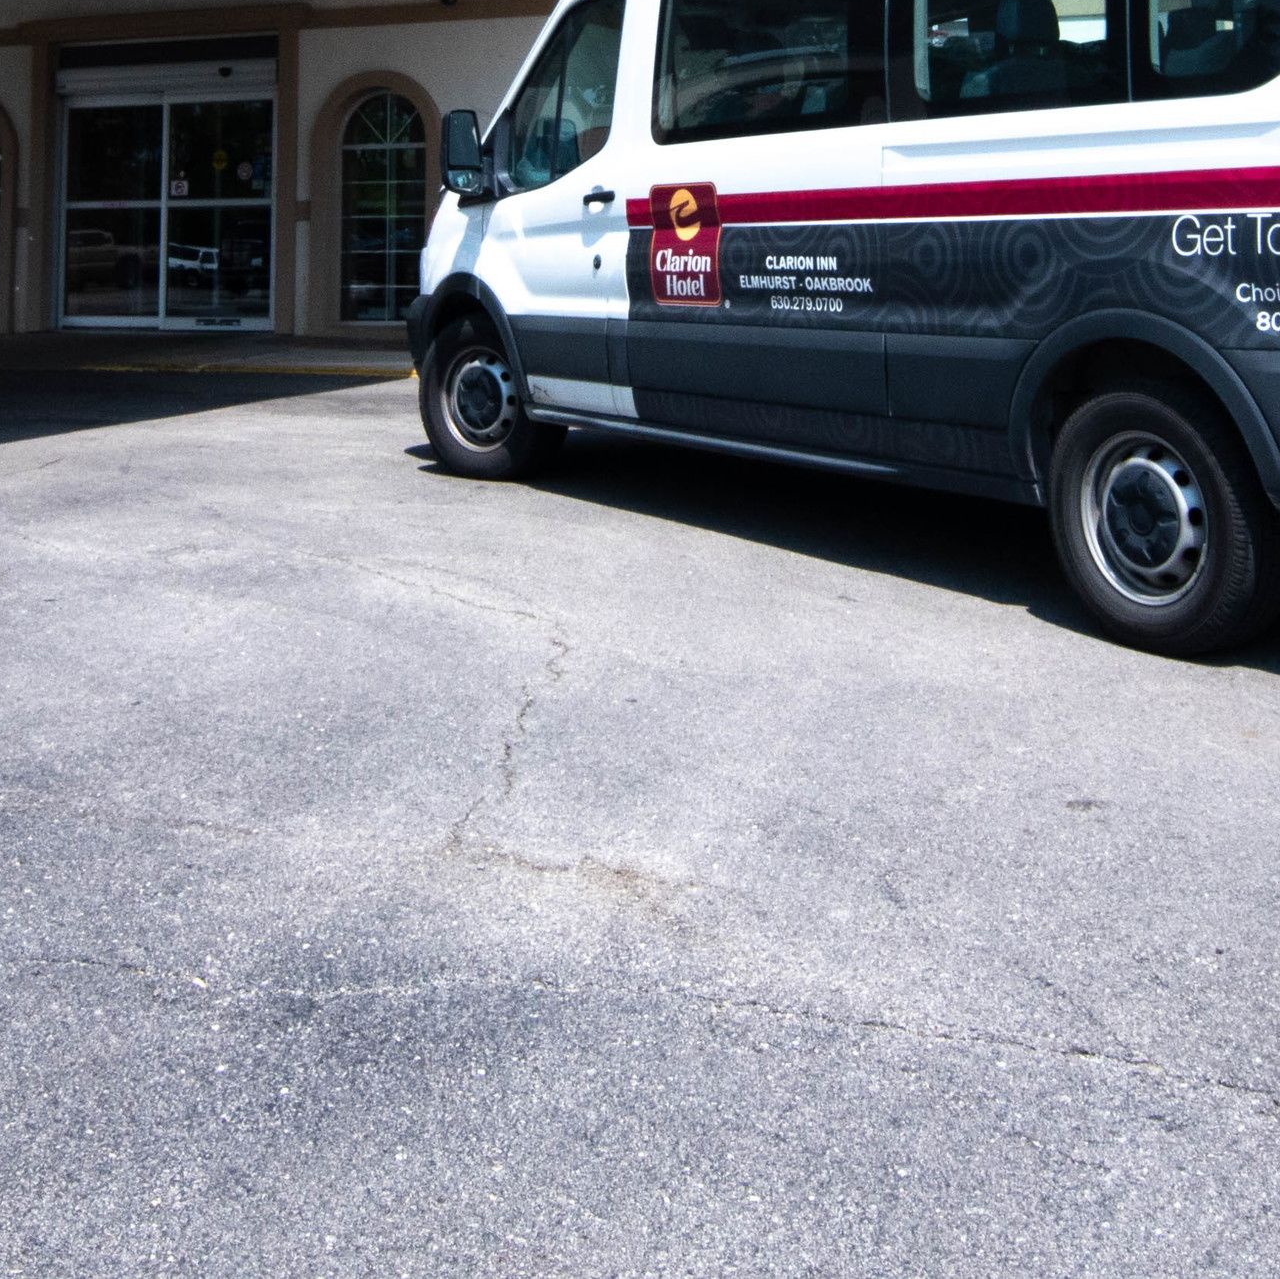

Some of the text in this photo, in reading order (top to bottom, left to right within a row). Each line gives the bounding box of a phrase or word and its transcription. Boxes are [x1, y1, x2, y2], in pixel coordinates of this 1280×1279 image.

[1171, 214, 1237, 257] Get
[655, 248, 711, 273] Clarion
[765, 255, 838, 271] CLARION INN
[665, 274, 705, 297] Hotel
[739, 274, 797, 290] ELMHURST
[805, 276, 874, 293] OAKBROOK
[770, 294, 843, 313] 630.279.0700
